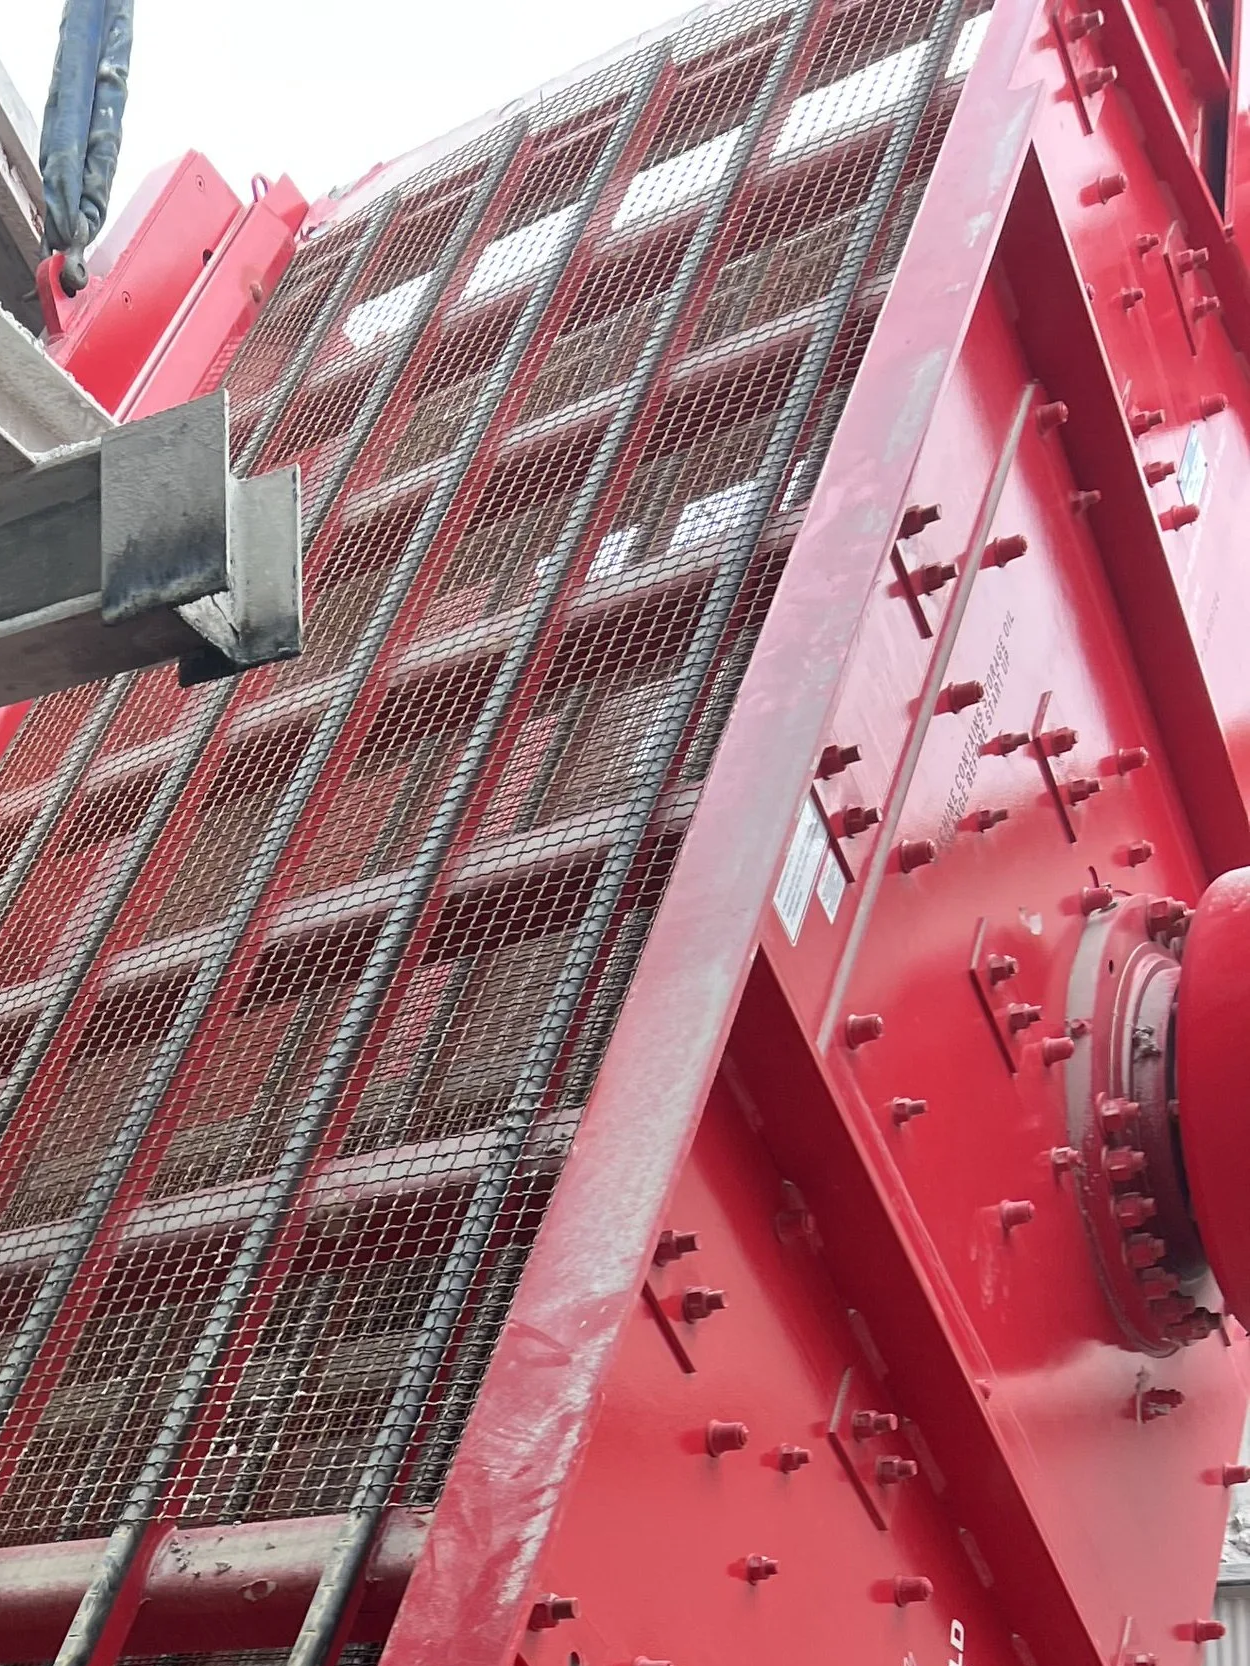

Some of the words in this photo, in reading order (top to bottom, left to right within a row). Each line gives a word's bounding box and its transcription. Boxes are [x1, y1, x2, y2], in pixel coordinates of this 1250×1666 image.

[955, 706, 983, 790] CONTAINS
[1003, 610, 1015, 637] OIL
[985, 671, 1004, 726] START
[1000, 649, 1010, 675] UP
